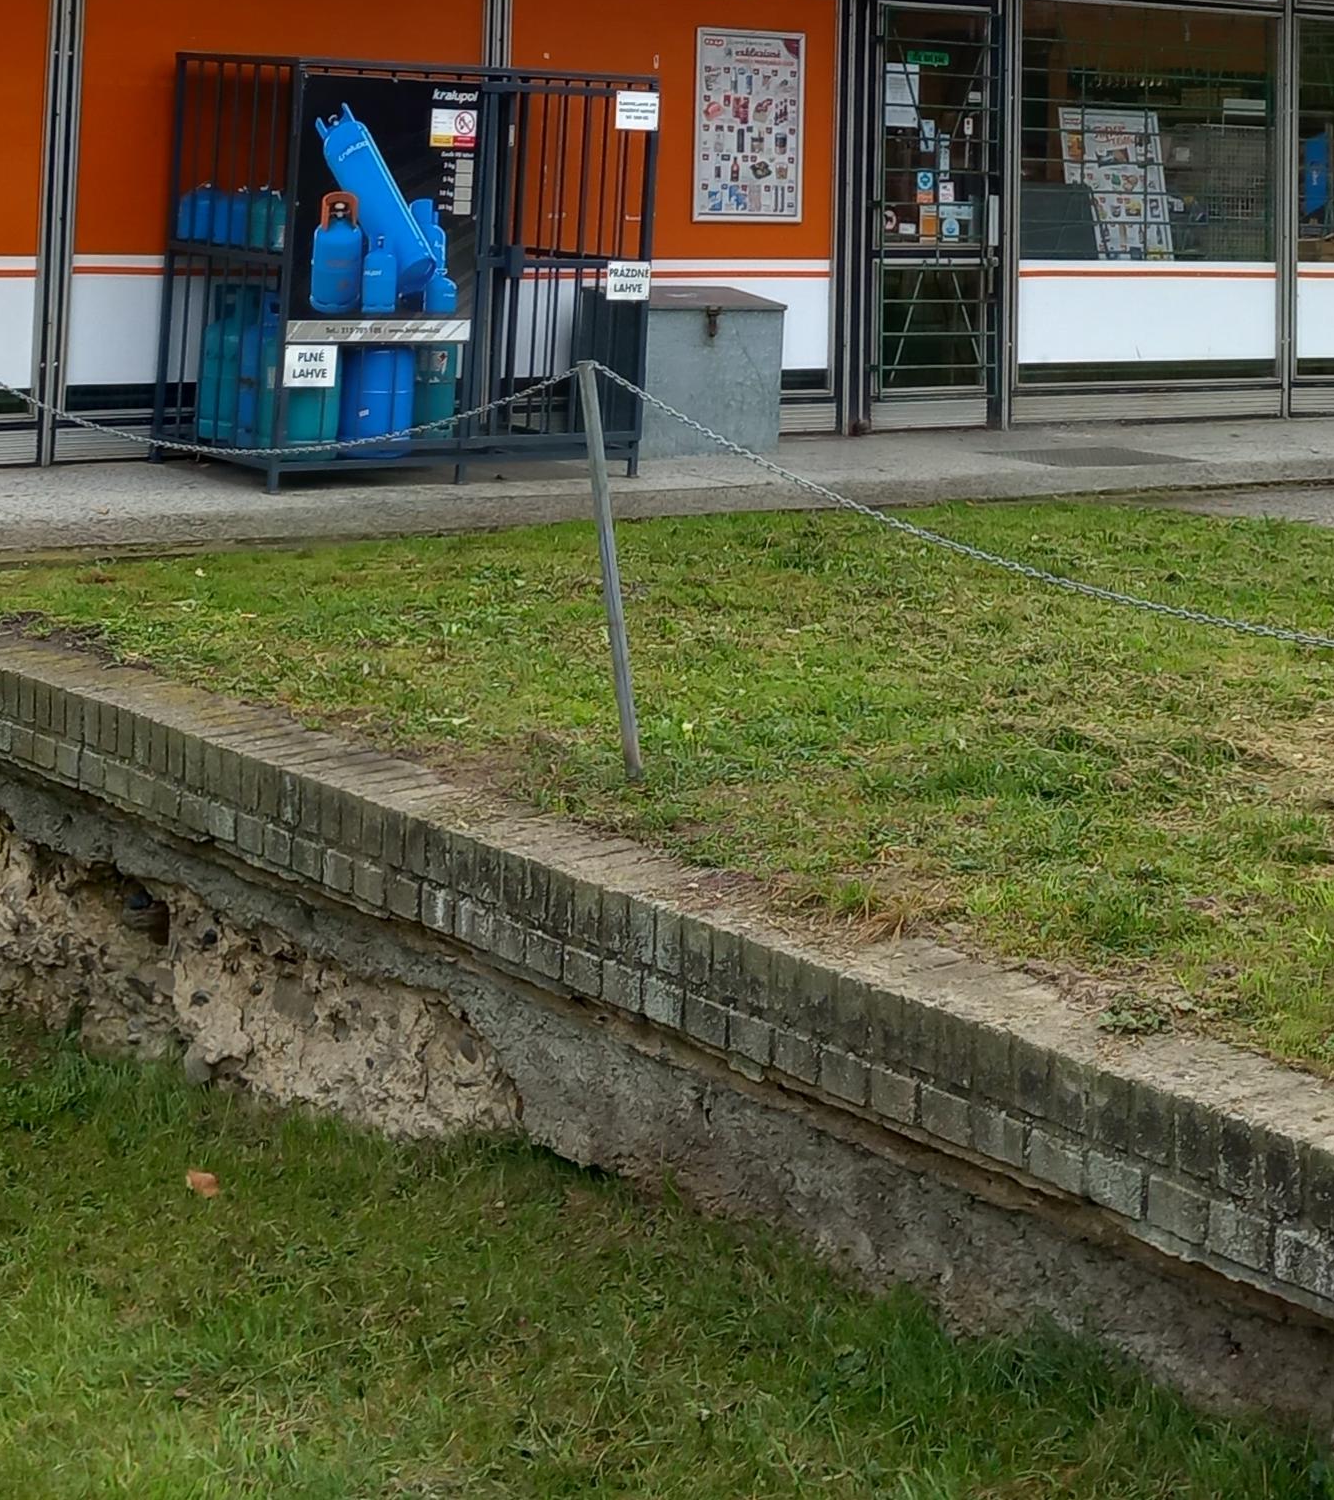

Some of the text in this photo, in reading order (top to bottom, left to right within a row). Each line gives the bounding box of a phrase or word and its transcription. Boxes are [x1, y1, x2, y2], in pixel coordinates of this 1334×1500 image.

[432, 88, 478, 104] kralupol
[609, 264, 650, 278] PRÁZDNÉ
[613, 283, 643, 293] LAHVE
[297, 348, 324, 363] PLNÉ
[292, 368, 328, 379] LAHVE
